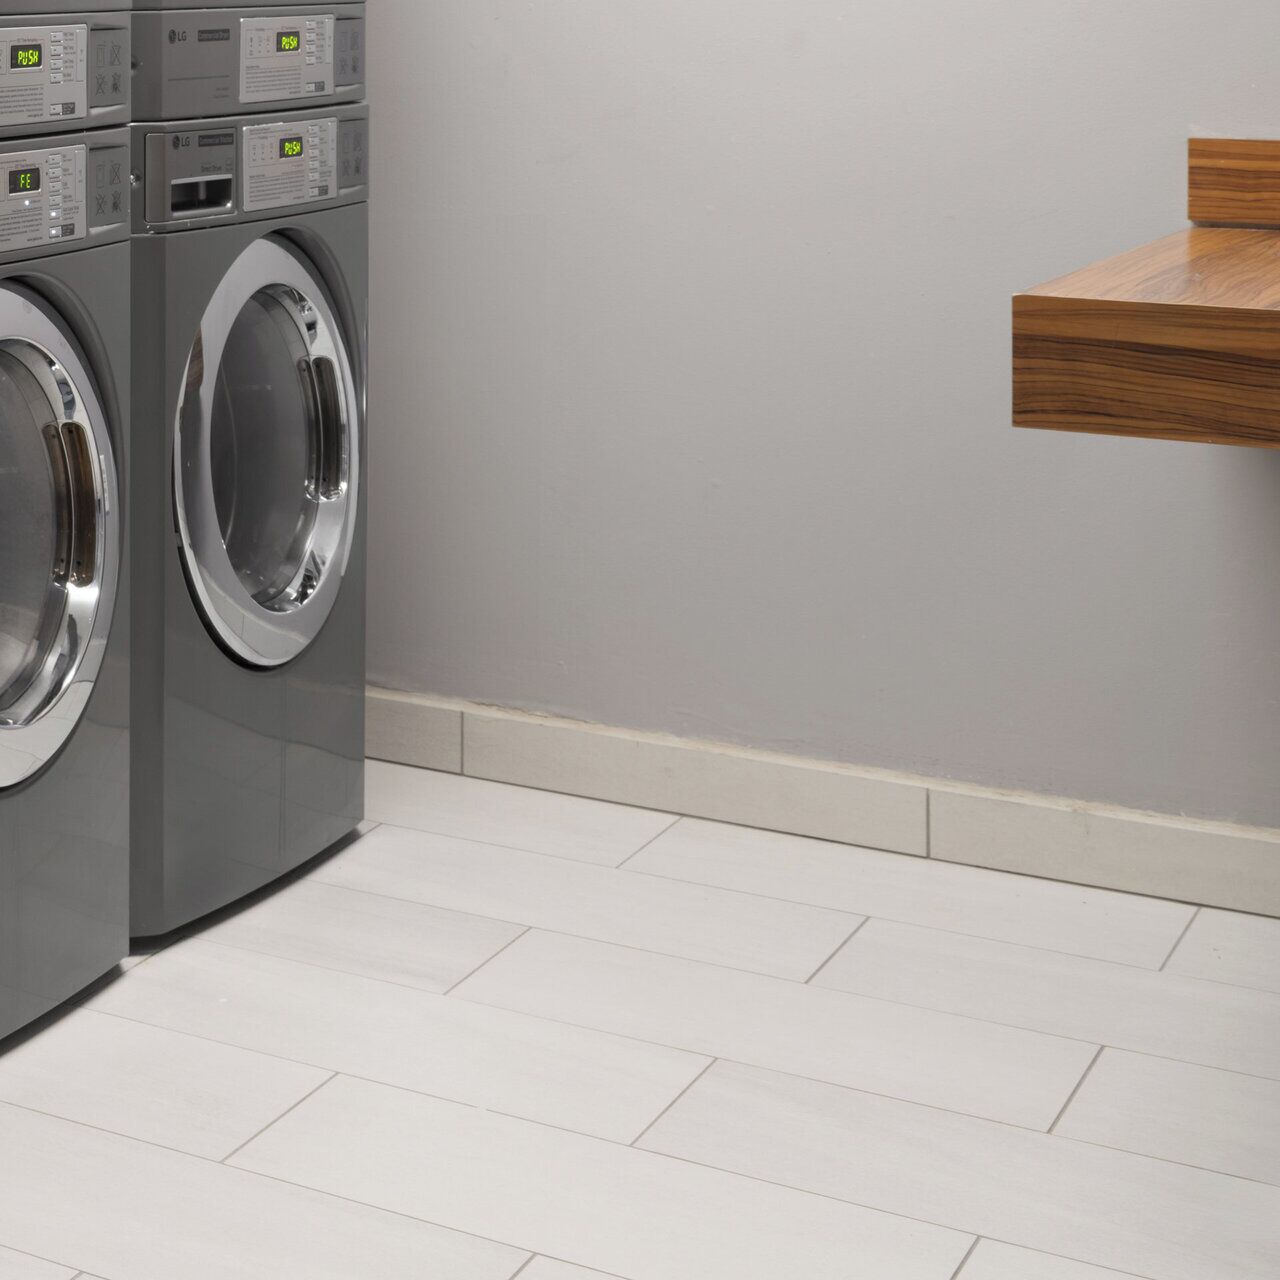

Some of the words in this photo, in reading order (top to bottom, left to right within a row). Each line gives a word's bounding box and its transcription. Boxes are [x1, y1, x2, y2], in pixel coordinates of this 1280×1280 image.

[177, 31, 186, 41] LG
[282, 36, 297, 49] PUSH
[18, 51, 38, 65] PUSH
[181, 136, 189, 146] LG
[285, 141, 300, 154] PUSH
[20, 174, 30, 188] FE
